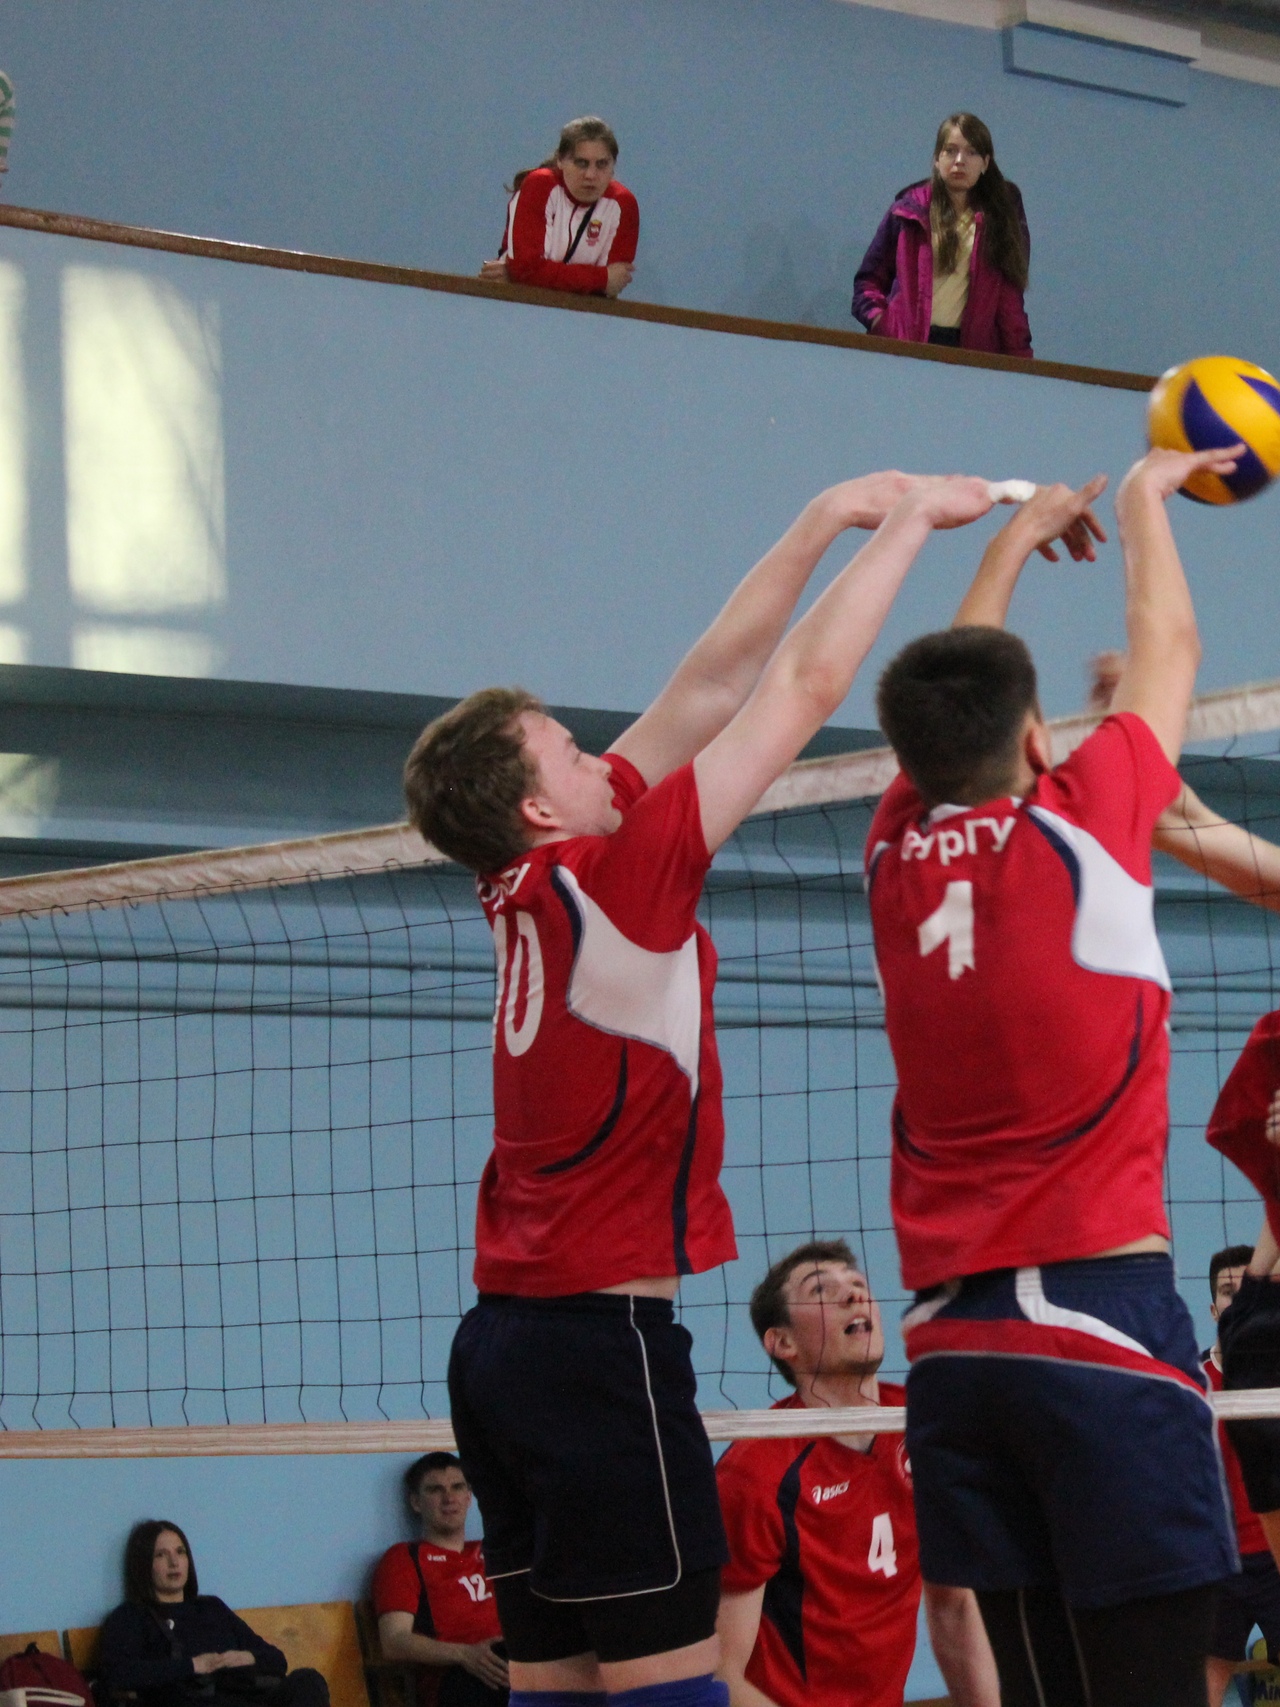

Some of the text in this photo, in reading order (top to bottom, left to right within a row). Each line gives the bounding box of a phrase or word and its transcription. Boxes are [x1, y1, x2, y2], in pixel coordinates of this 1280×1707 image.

[918, 880, 976, 981] 1
[493, 910, 545, 1058] 10
[458, 1573, 493, 1602] 12
[867, 1512, 898, 1579] 4
